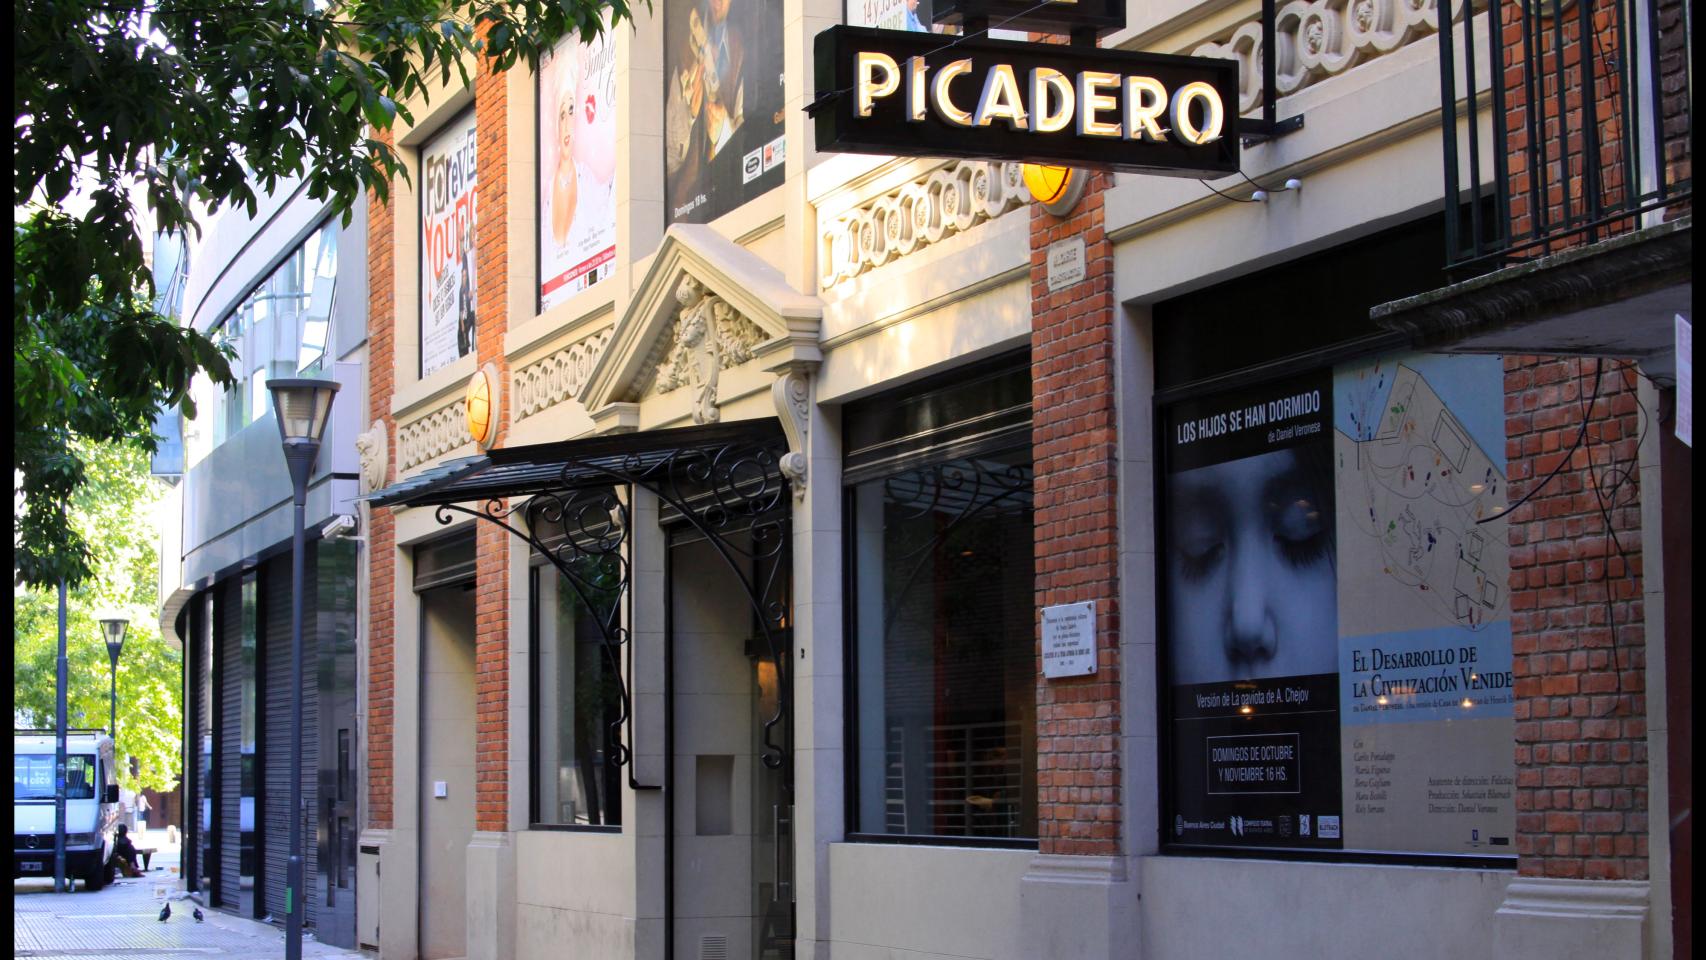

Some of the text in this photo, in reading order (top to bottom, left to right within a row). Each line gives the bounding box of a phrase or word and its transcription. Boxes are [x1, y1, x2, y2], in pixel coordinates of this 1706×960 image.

[853, 51, 1225, 146] PICADERO
[1177, 389, 1321, 444] LOS HIJOS SE HAN DORMIDO
[1267, 431, 1276, 444] de
[1276, 427, 1294, 442] Daniel
[1196, 692, 1220, 708] Versión
[1221, 692, 1230, 706] de
[1231, 691, 1240, 706] La
[1266, 688, 1275, 704] de
[1275, 687, 1284, 703] A.
[1212, 745, 1294, 762] DOMINGOS DE OCTUBRE
[1218, 767, 1224, 782] Y
[1224, 766, 1265, 782] NOVIEMBRE
[1265, 766, 1274, 781] 16
